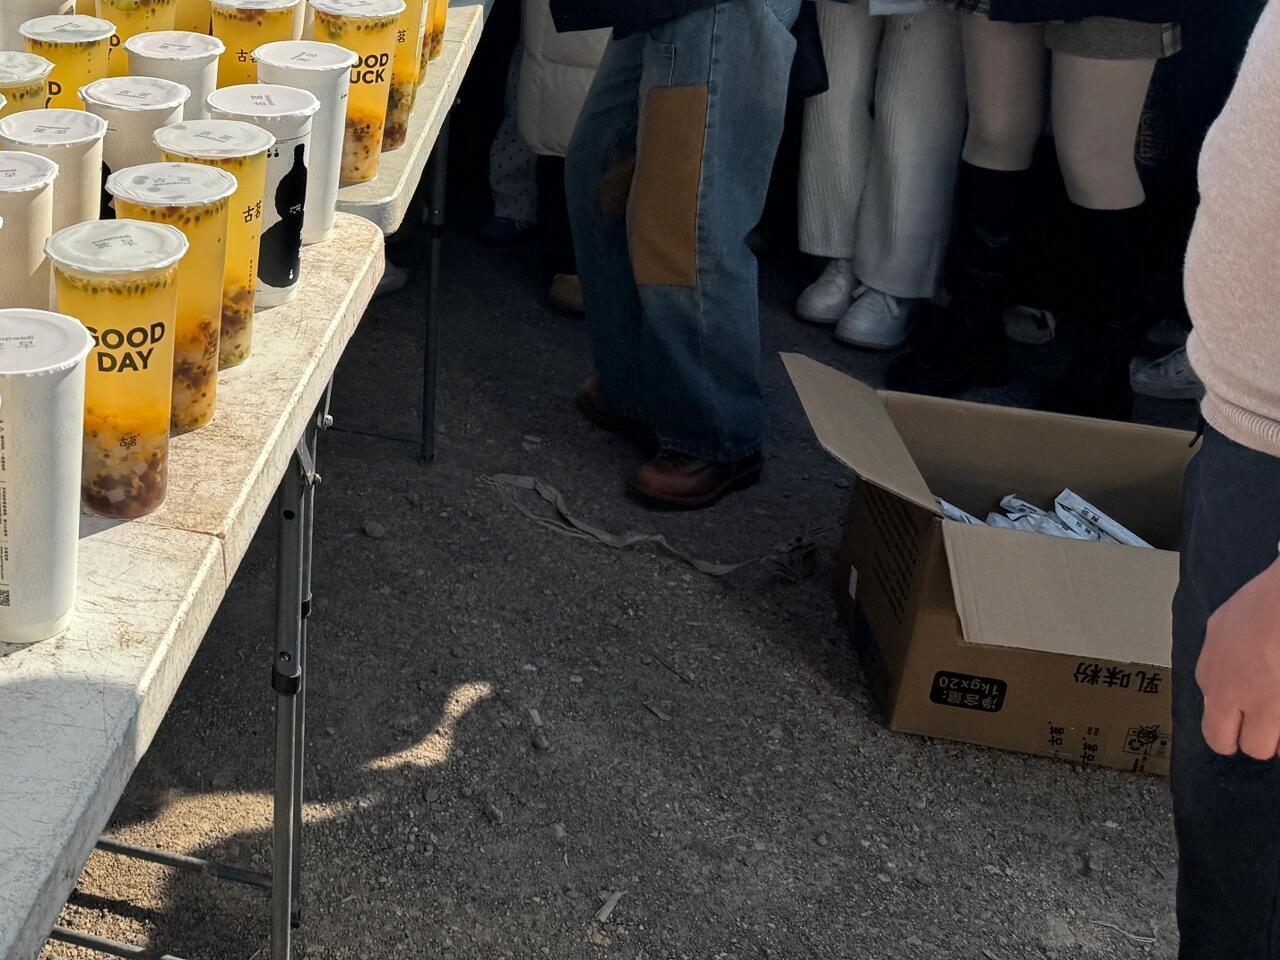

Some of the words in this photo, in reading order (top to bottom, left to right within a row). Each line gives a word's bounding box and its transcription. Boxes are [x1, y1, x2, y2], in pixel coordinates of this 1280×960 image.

[351, 53, 389, 68] OOD
[349, 68, 386, 84] UCK
[243, 199, 262, 222] 古茗
[97, 347, 154, 373] DAY
[1073, 662, 1162, 693] 乳味粉
